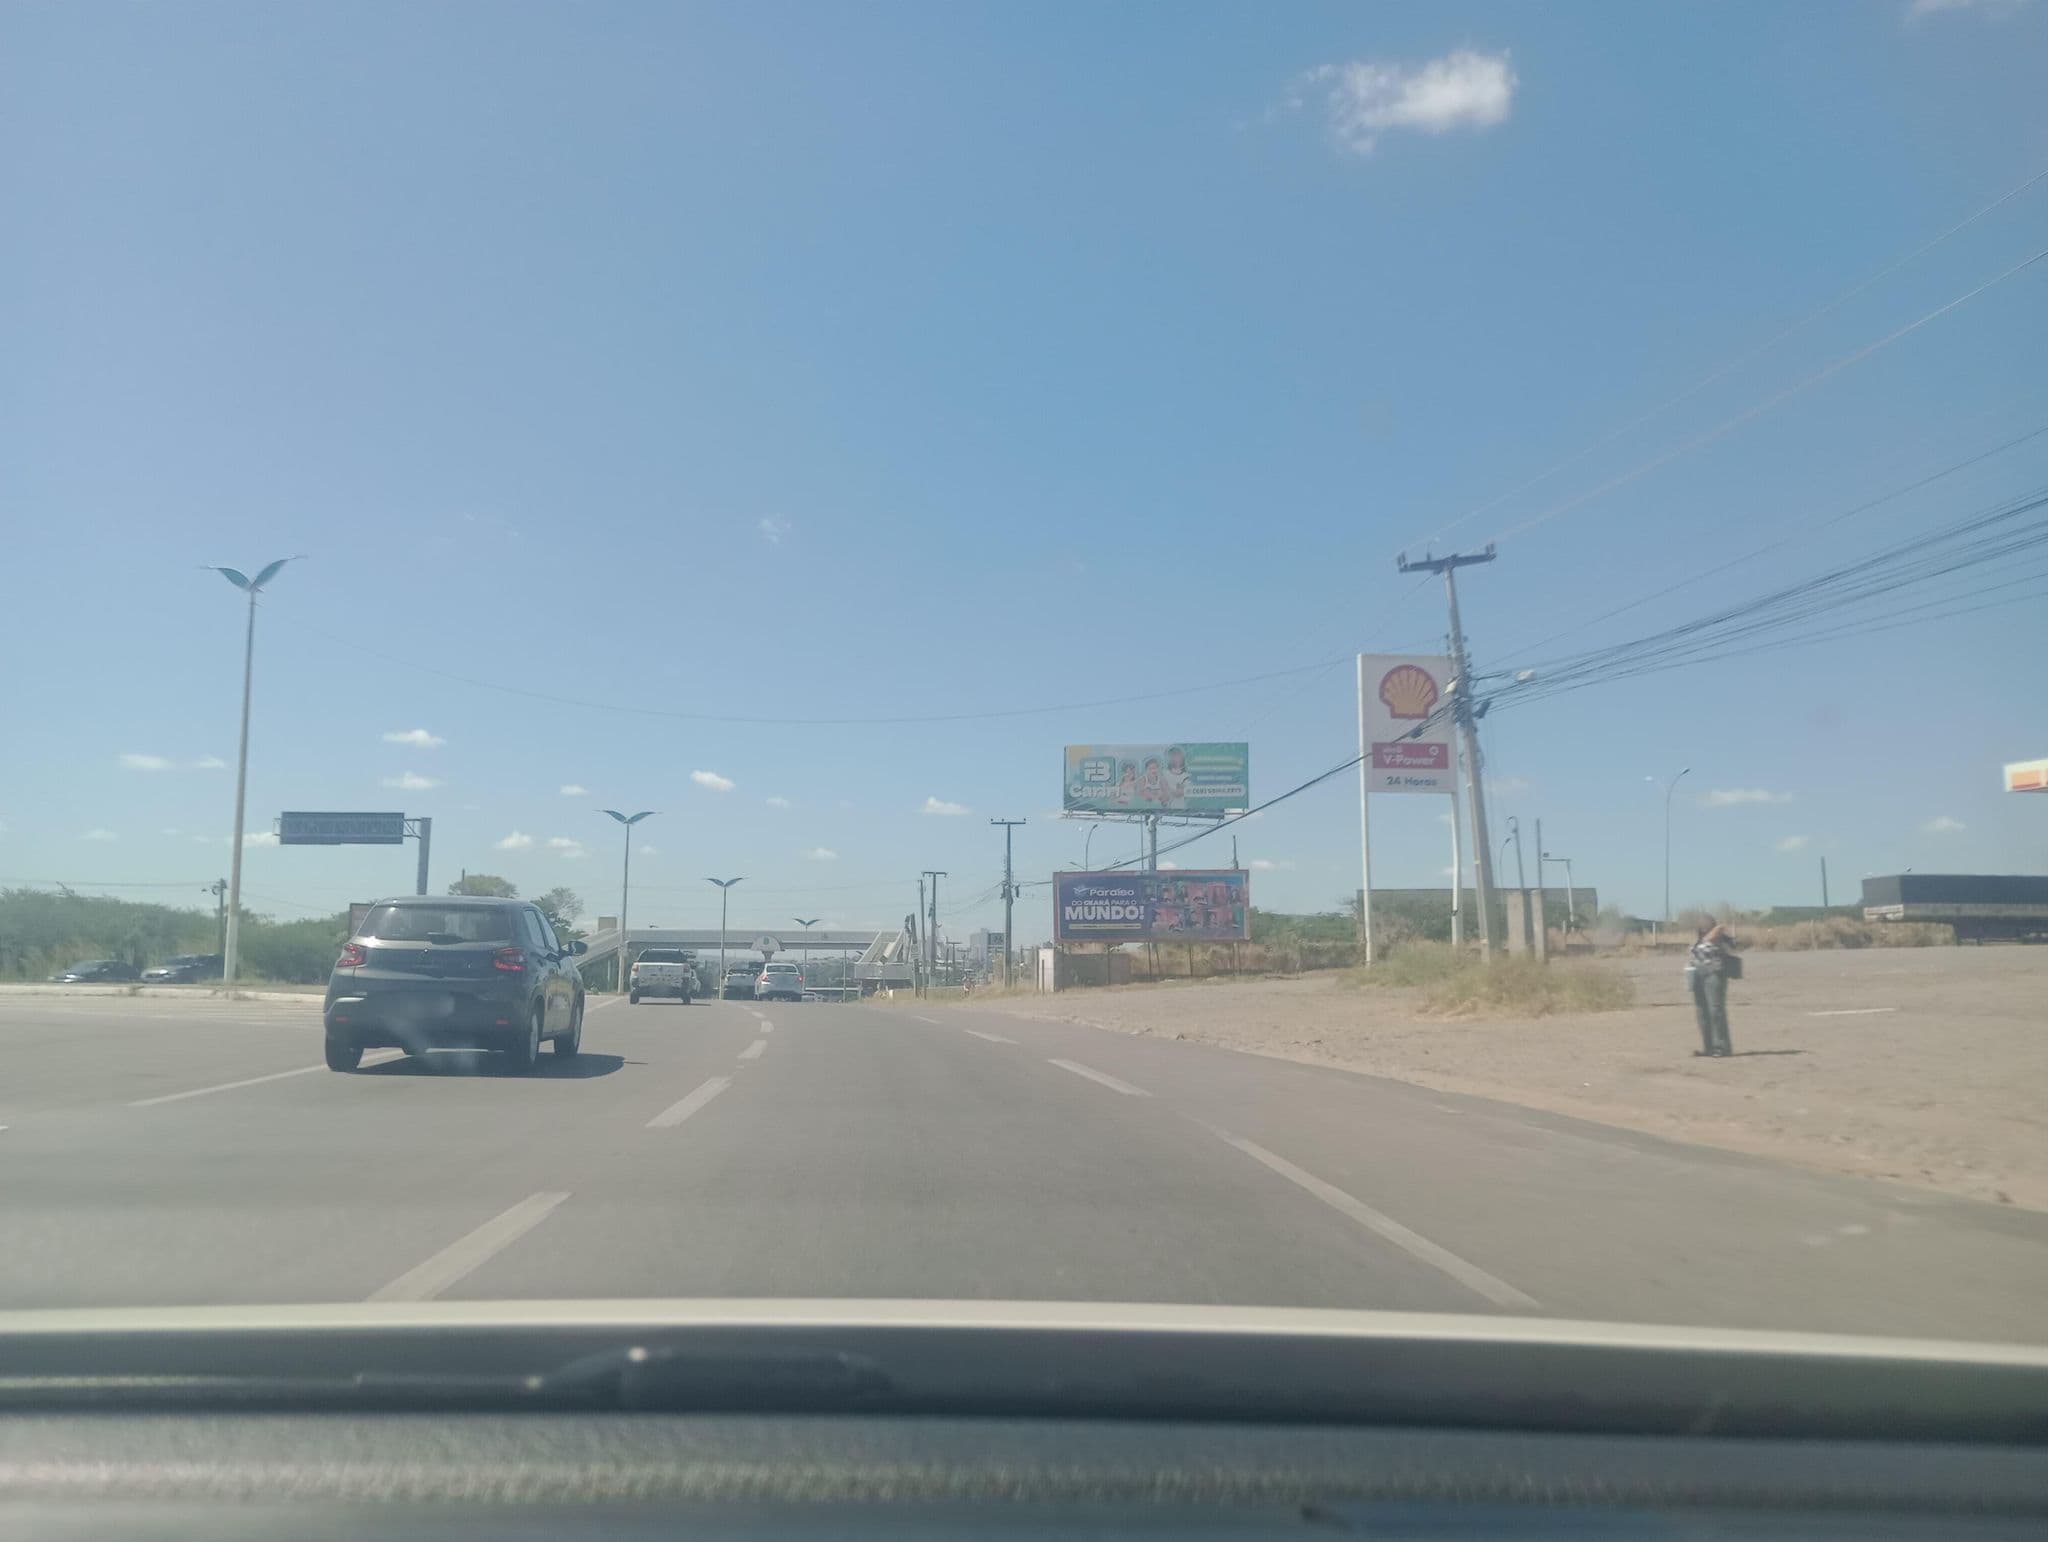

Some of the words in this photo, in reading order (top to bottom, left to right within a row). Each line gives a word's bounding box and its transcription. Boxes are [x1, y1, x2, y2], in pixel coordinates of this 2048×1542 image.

[1383, 755, 1436, 766] V-Power
[1386, 776, 1402, 785] 24
[1405, 776, 1437, 786] Horas
[1065, 906, 1145, 920] MUNDO!
